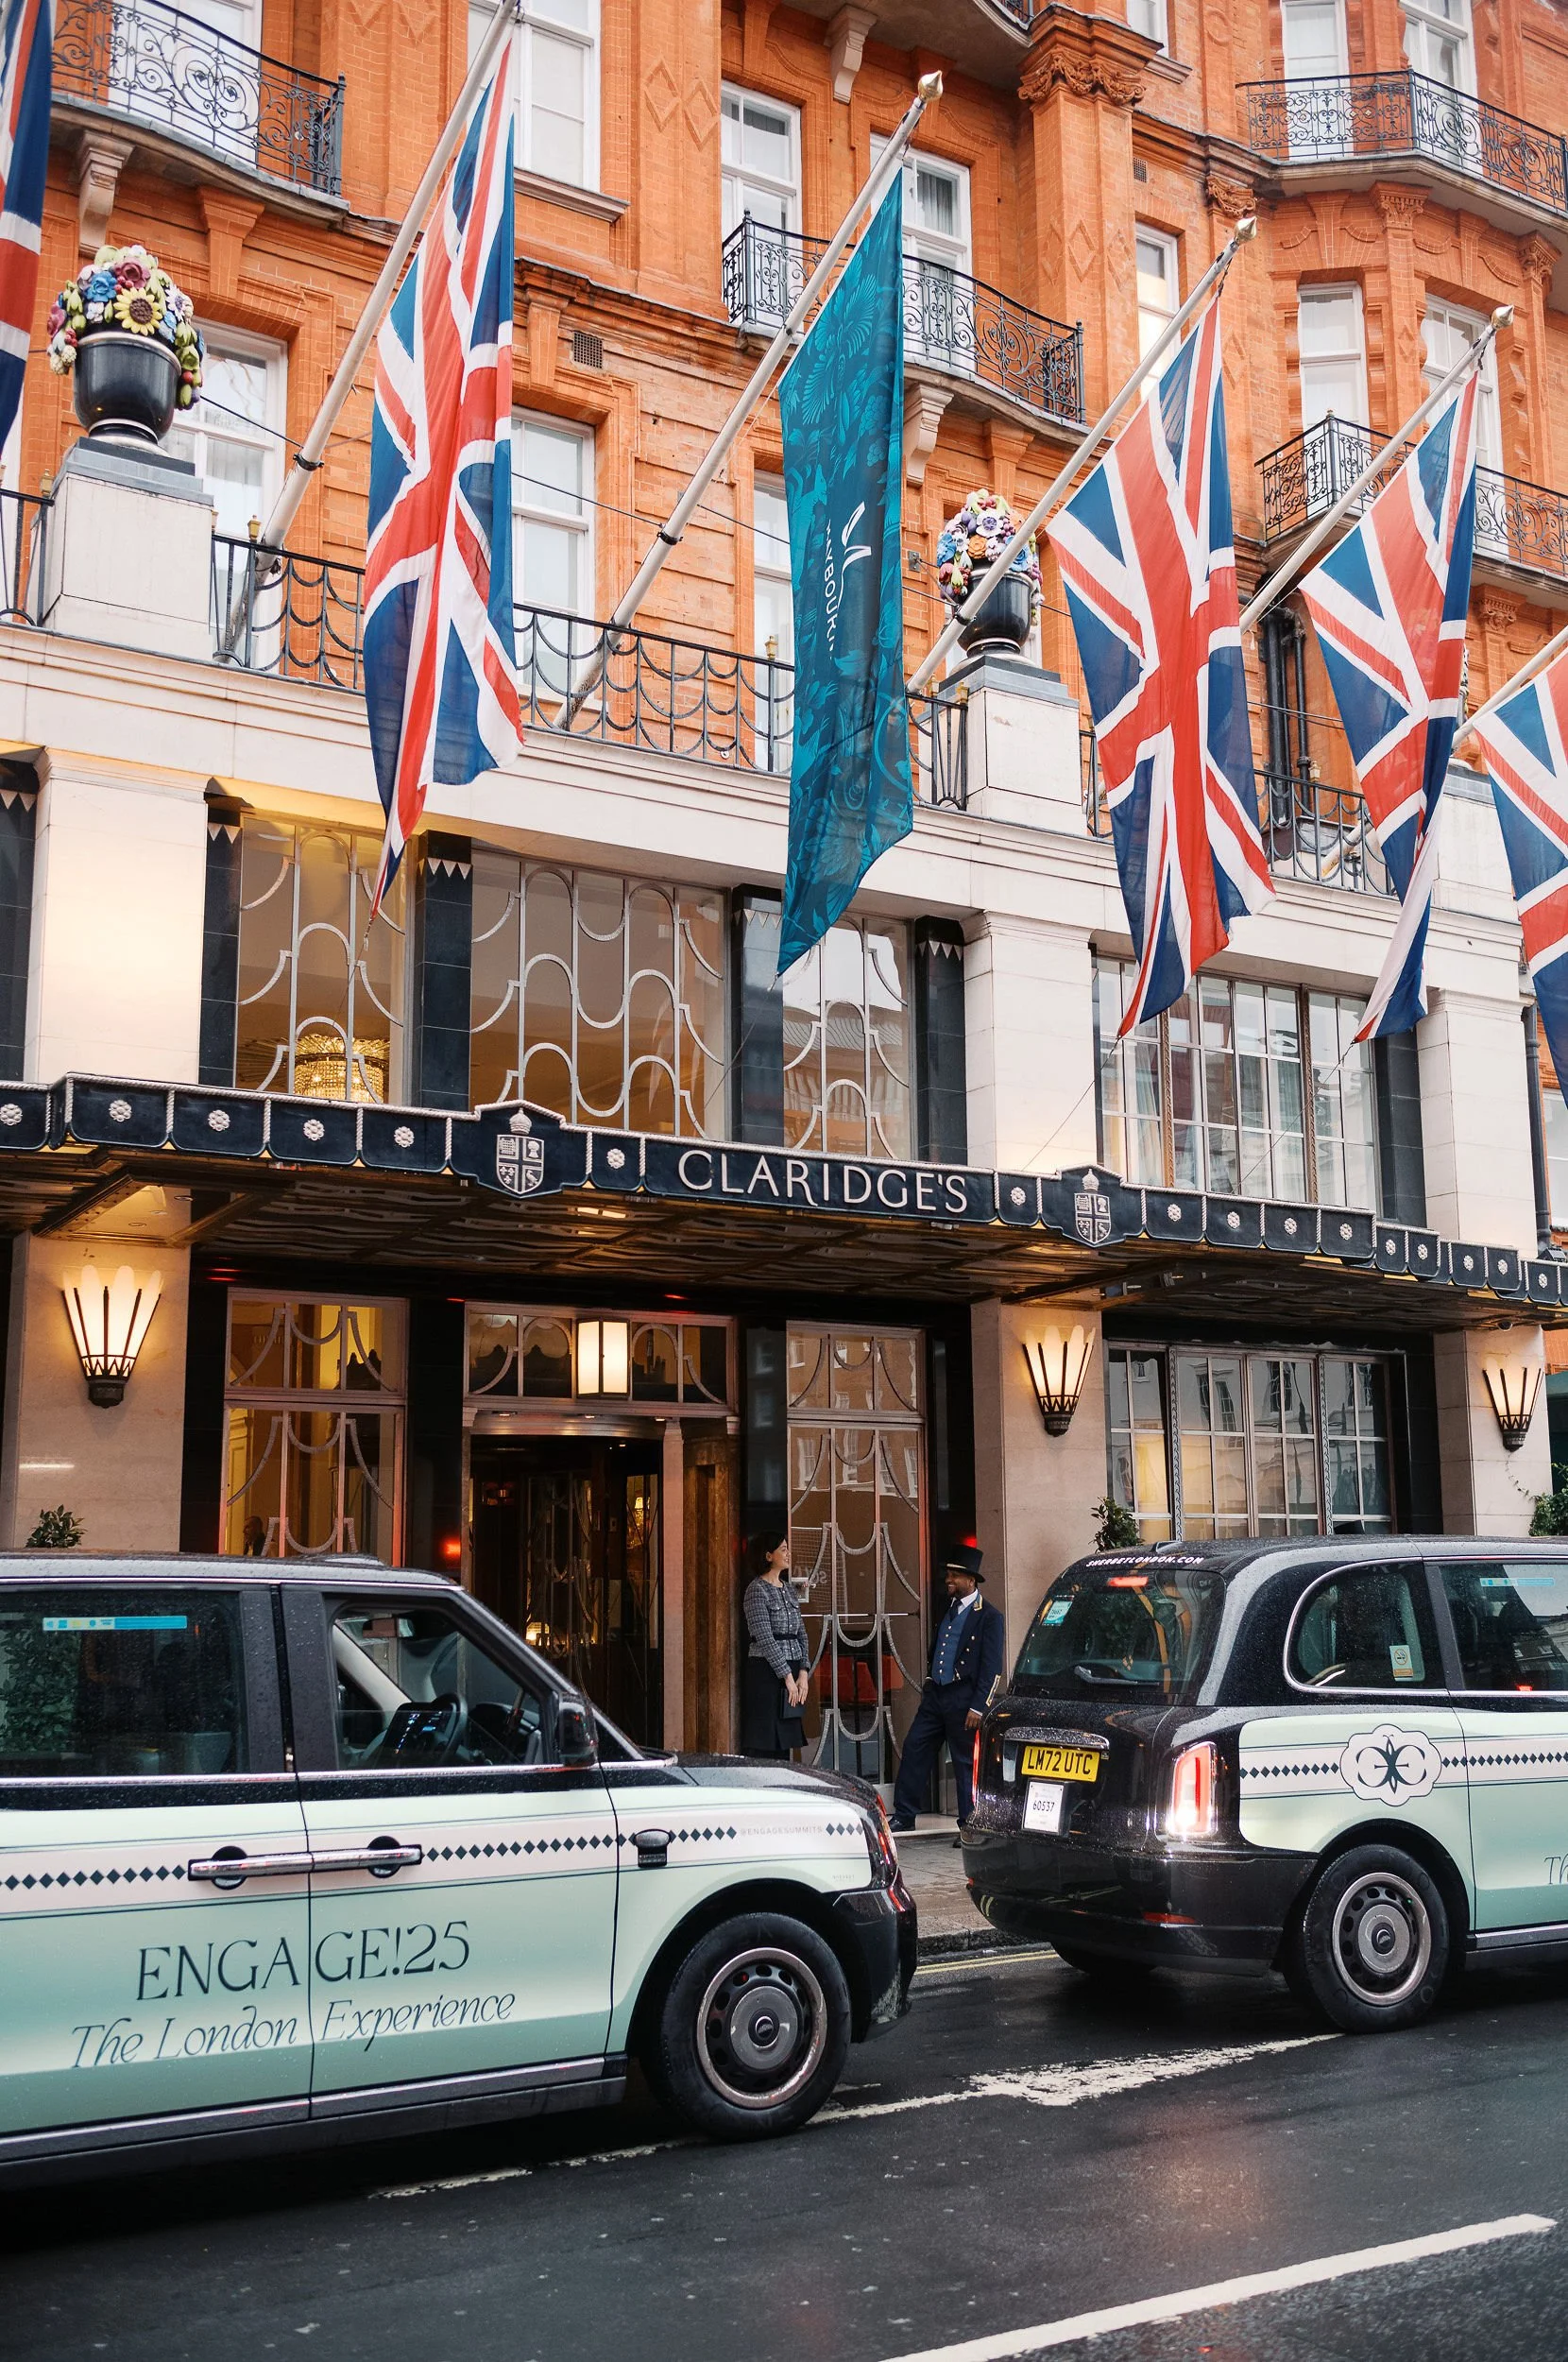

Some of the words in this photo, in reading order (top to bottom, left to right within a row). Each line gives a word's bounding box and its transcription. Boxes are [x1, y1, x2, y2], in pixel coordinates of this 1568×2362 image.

[677, 1149, 968, 1214] CLARIDGE'S
[1027, 1748, 1063, 1772] LM72
[1064, 1752, 1093, 1775] UTC
[1032, 1800, 1055, 1812] 60537
[71, 2017, 145, 2069] The
[155, 2005, 298, 2062] London
[322, 1992, 516, 2052] Experience
